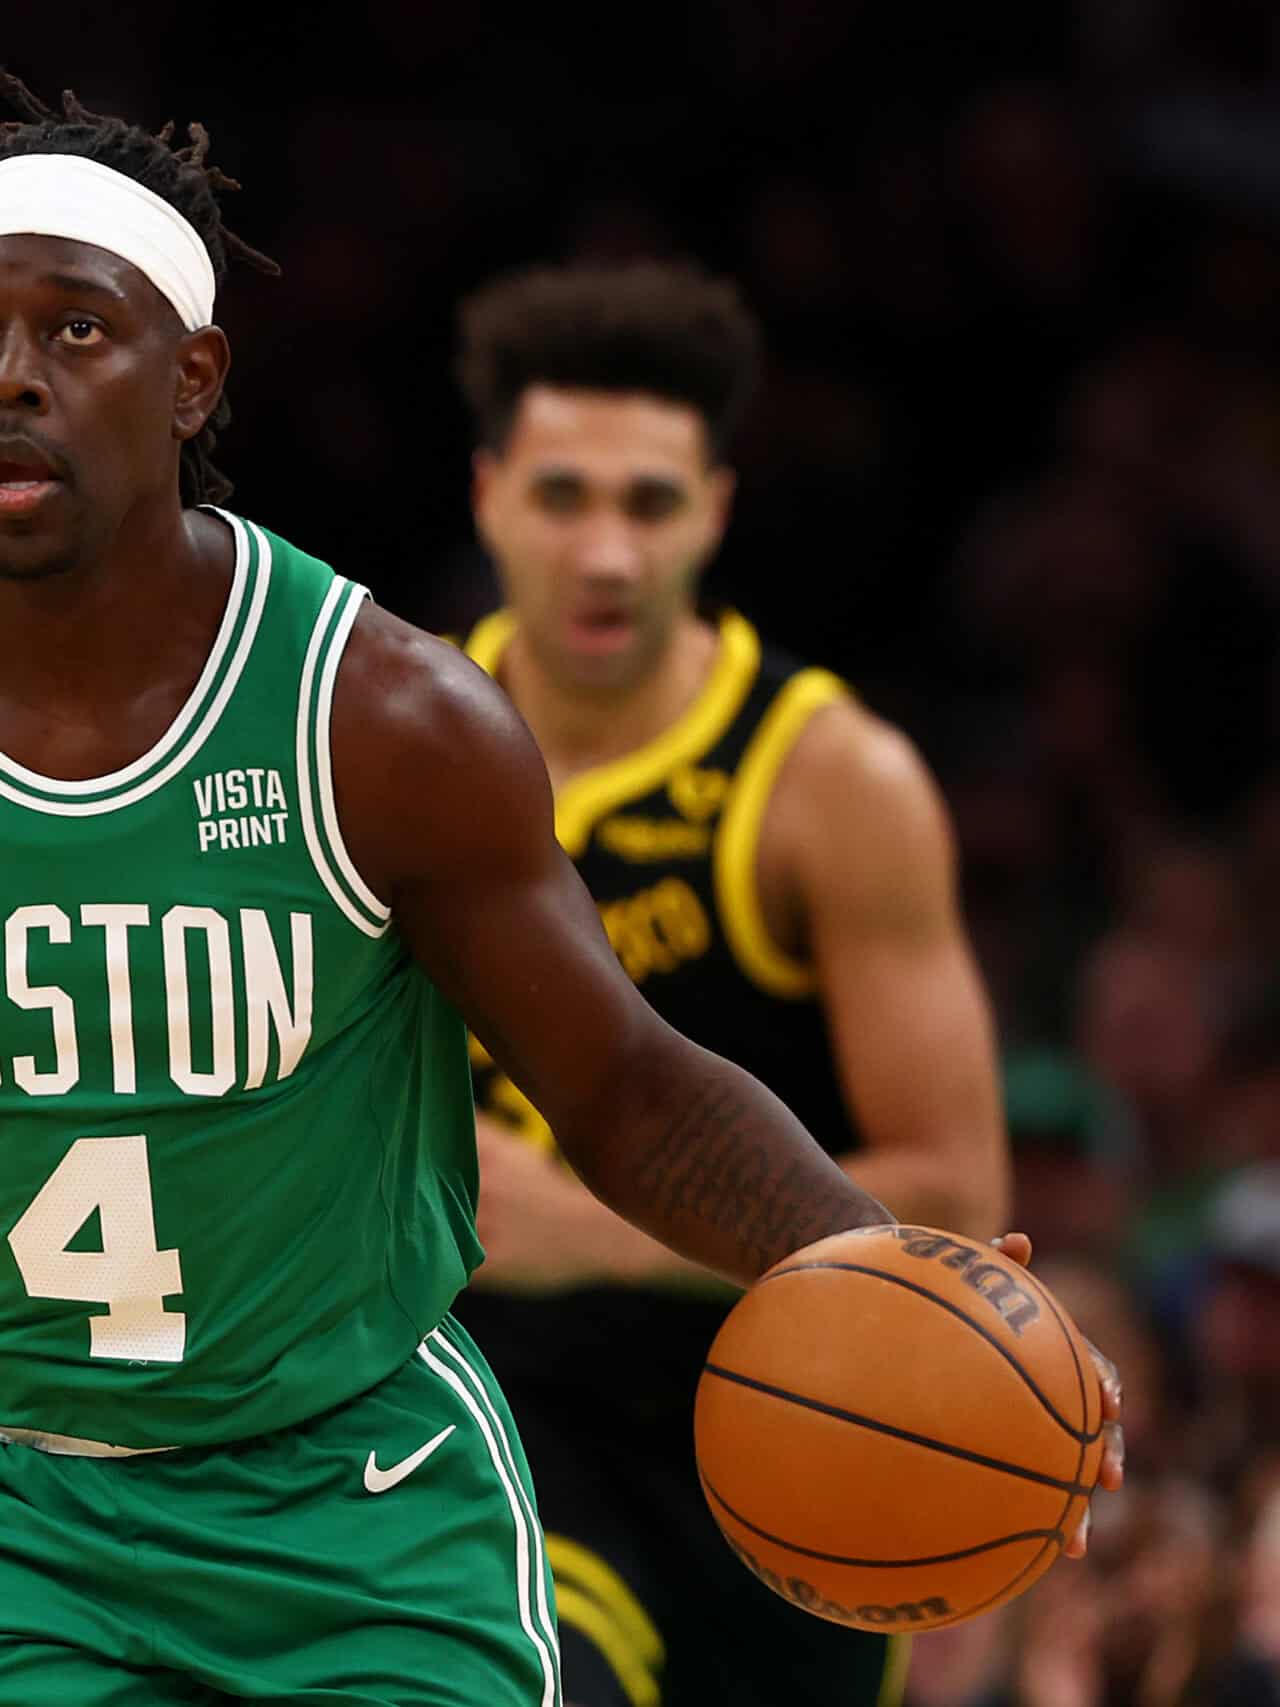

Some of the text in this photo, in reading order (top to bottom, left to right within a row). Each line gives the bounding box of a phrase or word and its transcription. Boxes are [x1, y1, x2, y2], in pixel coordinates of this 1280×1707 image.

[193, 768, 288, 818] VISTA
[198, 812, 289, 852] PRINT
[7, 1134, 187, 1366] 4
